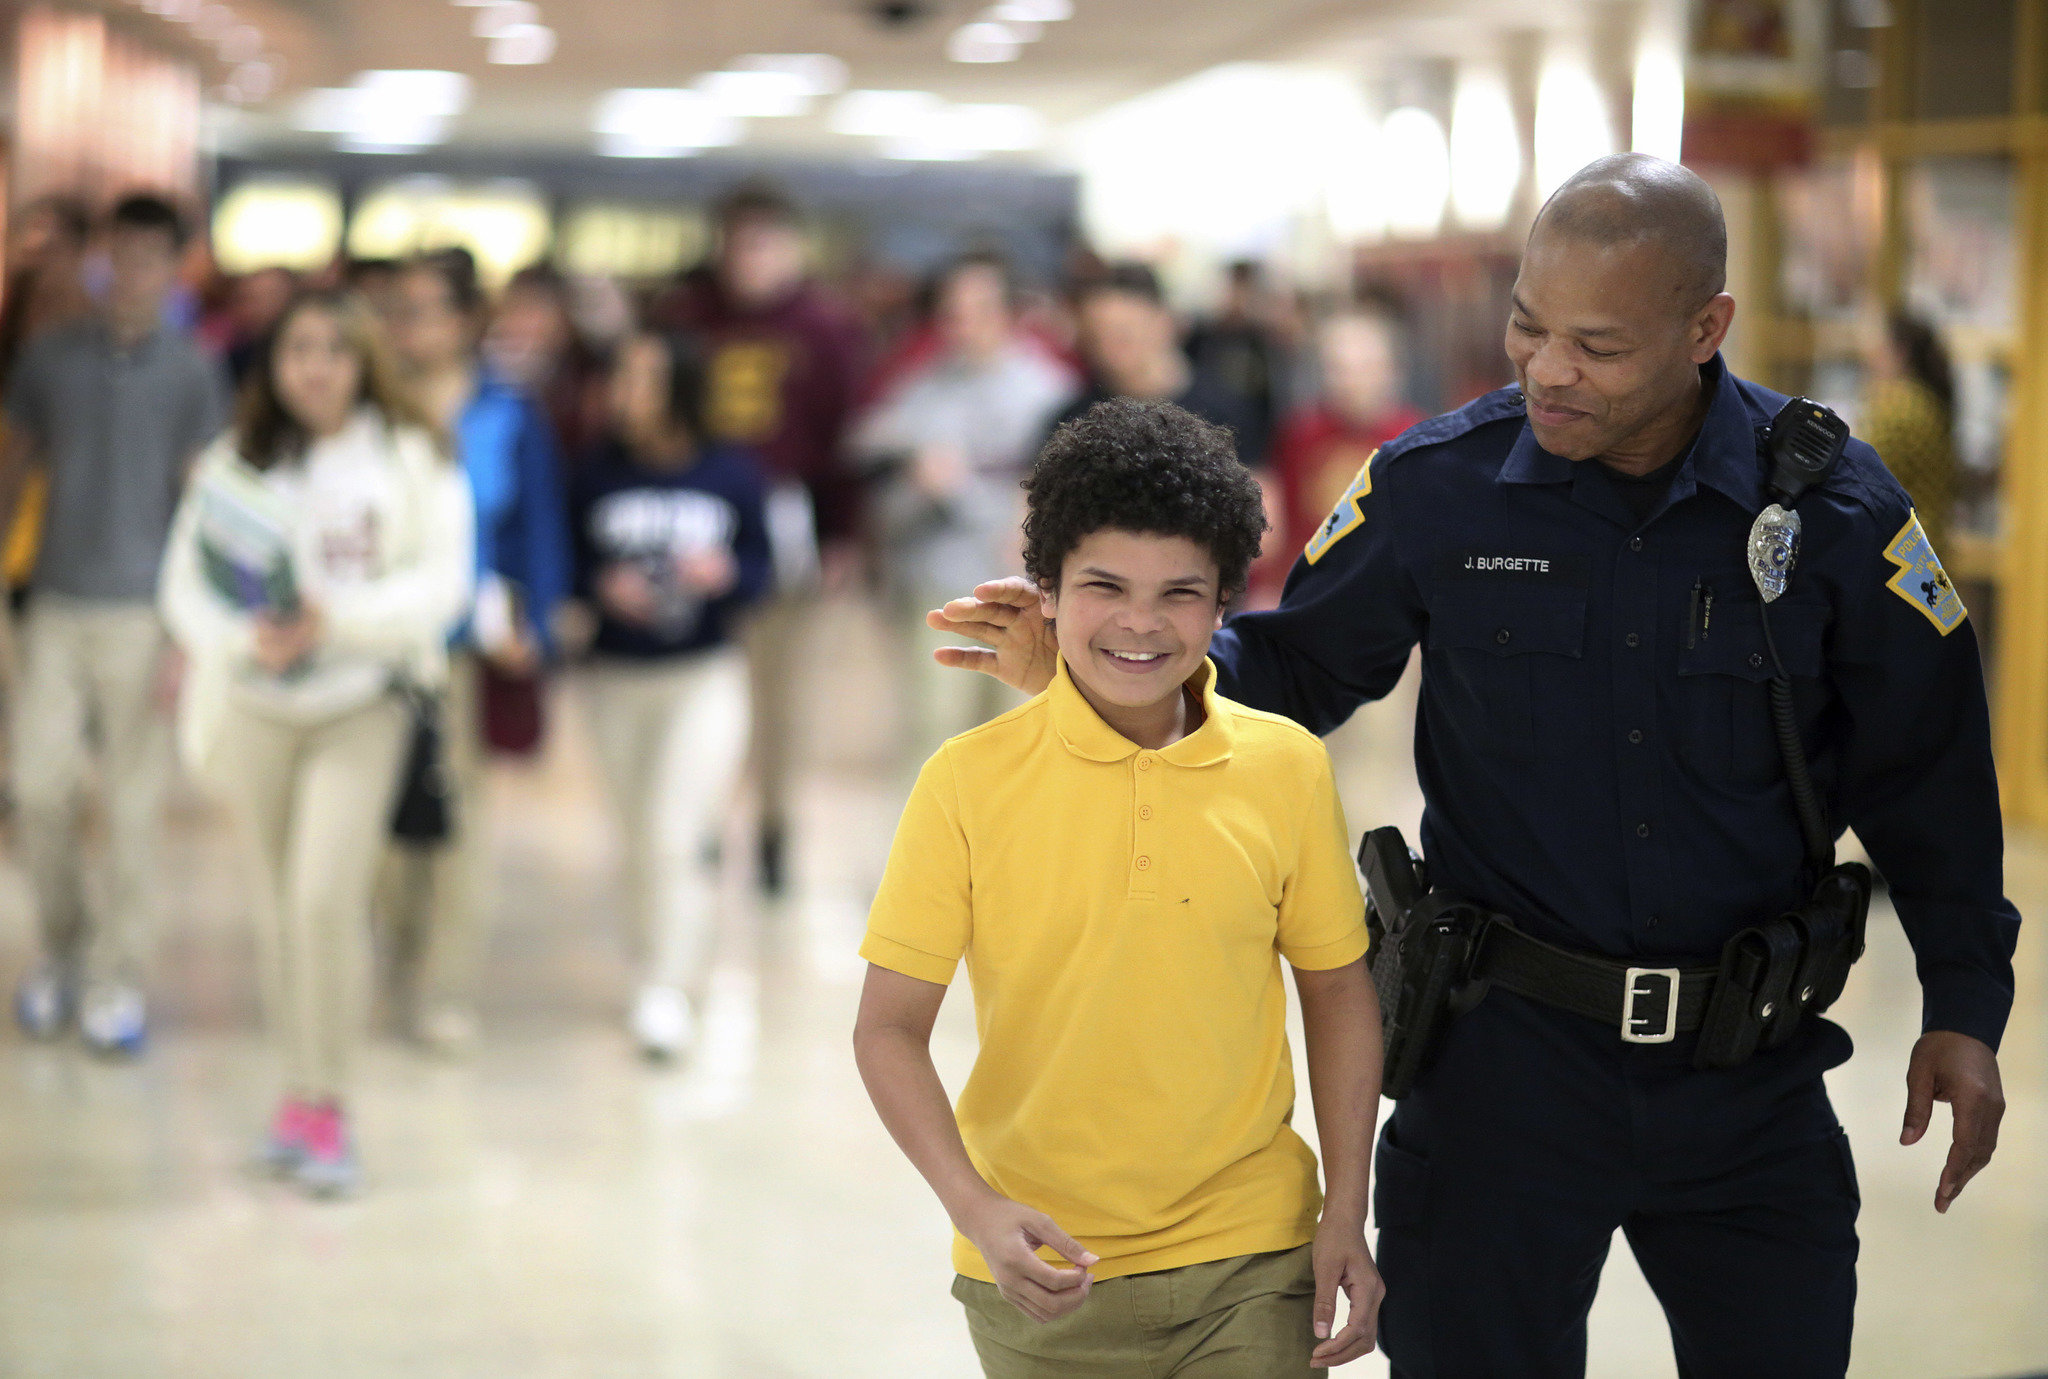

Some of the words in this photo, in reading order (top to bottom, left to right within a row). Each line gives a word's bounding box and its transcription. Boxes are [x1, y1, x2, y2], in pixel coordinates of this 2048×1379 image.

[1807, 419, 1835, 439] KENWOOD
[1897, 529, 1924, 558] POLIC
[1477, 557, 1550, 572] BURGETTE
